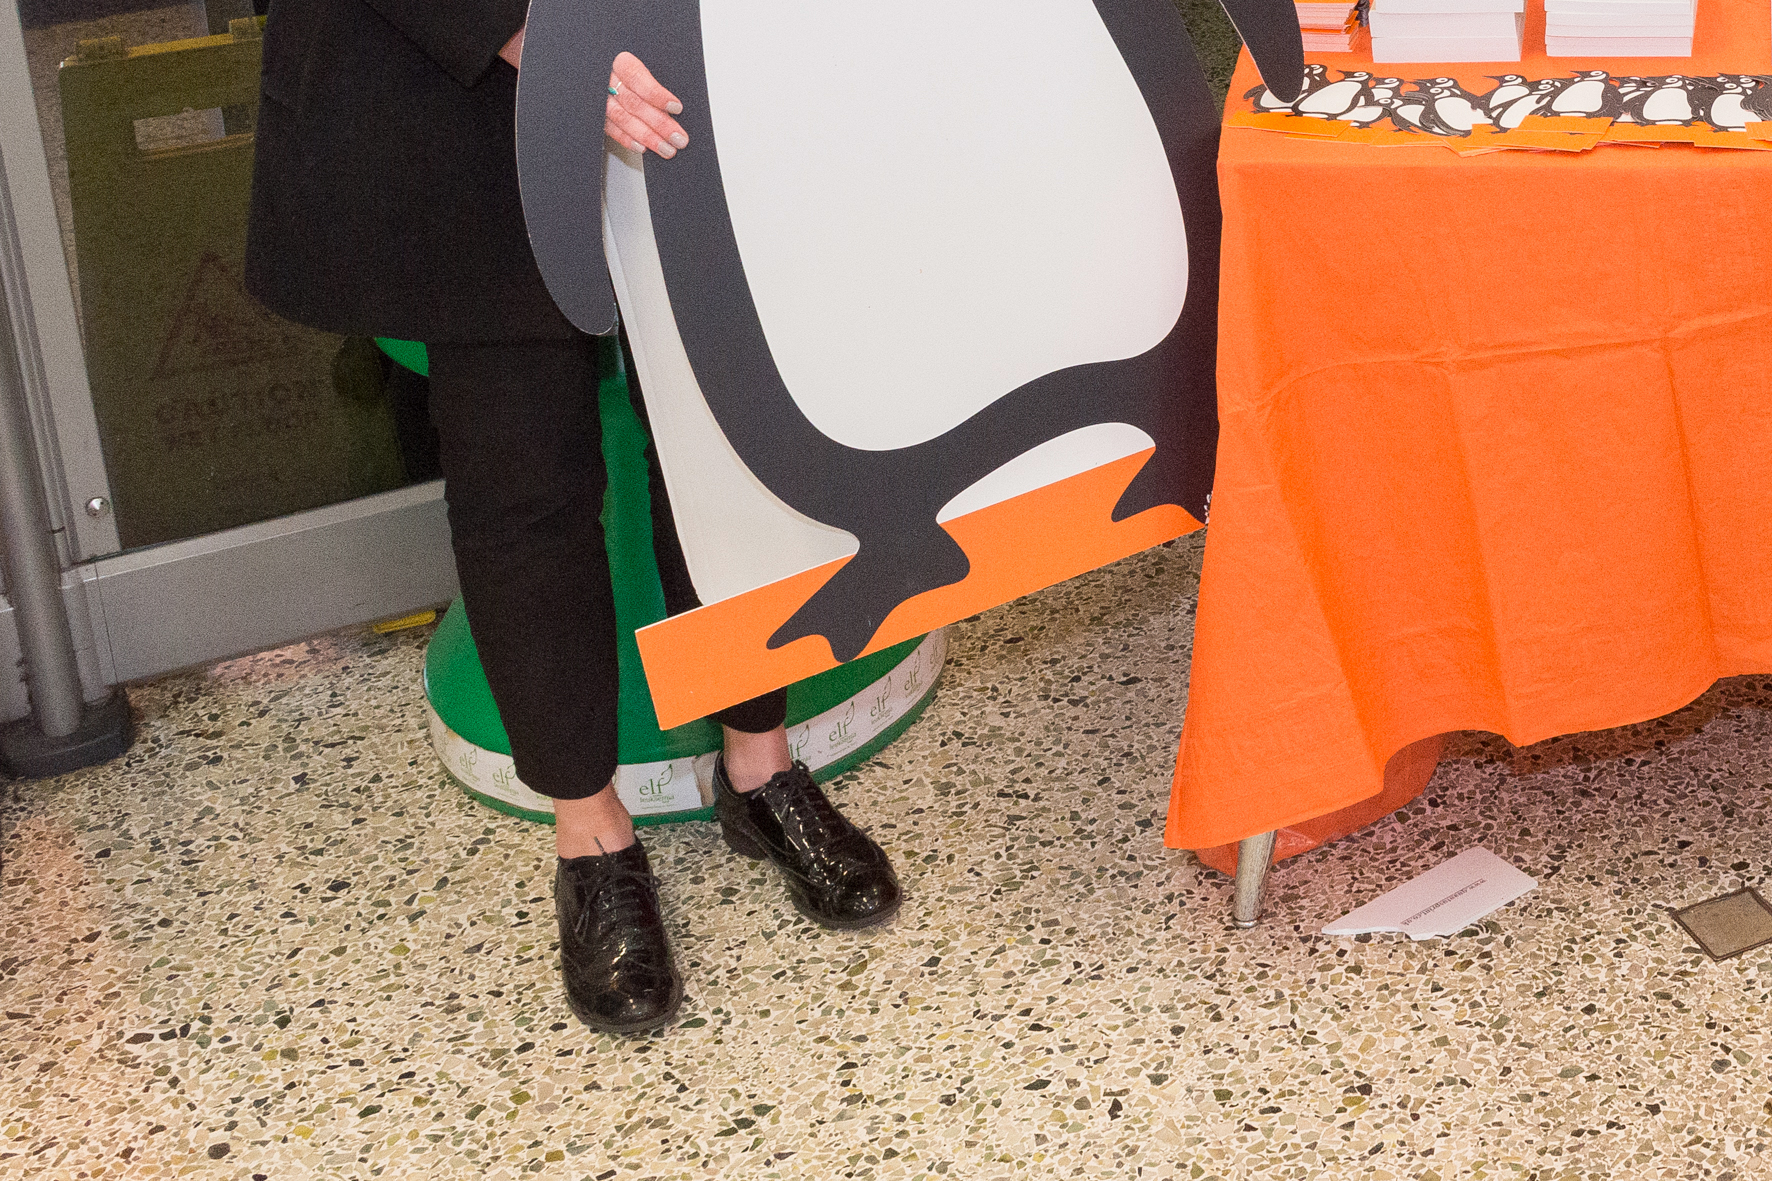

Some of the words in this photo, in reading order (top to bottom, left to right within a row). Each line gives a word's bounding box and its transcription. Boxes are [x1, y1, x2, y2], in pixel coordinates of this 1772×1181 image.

[871, 676, 892, 717] elf
[829, 701, 855, 742] elf
[639, 764, 673, 796] elf
